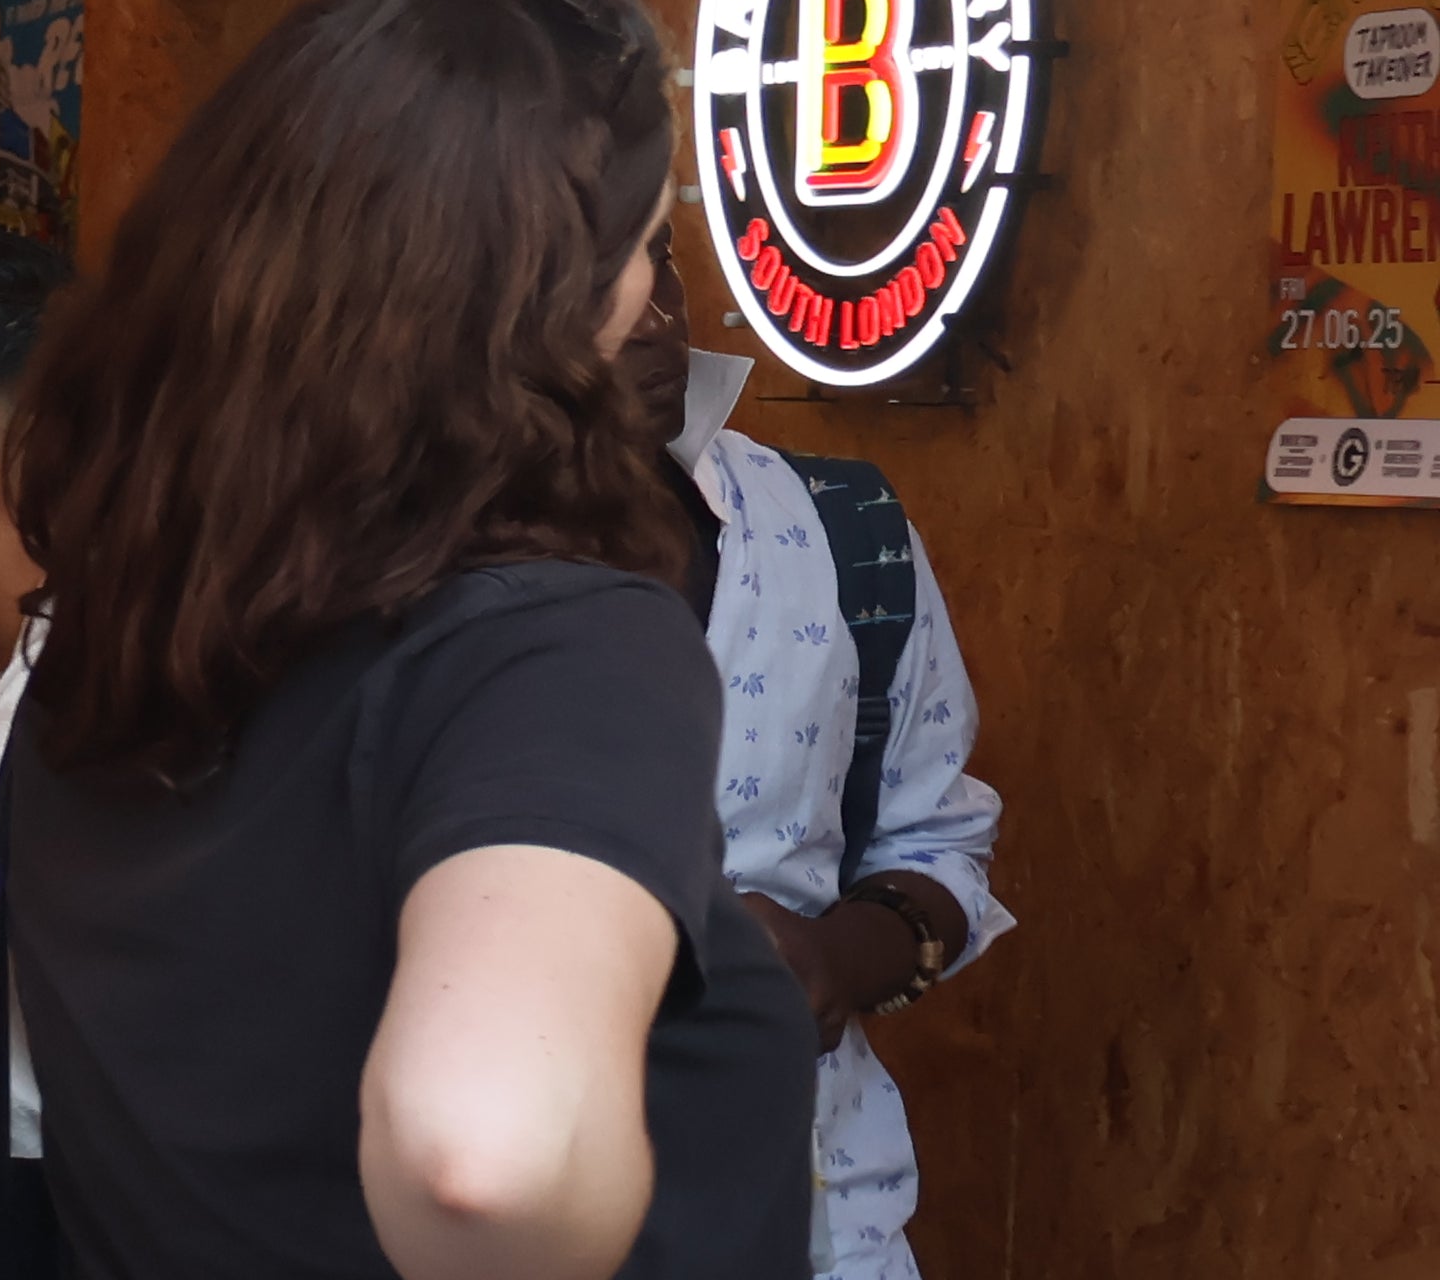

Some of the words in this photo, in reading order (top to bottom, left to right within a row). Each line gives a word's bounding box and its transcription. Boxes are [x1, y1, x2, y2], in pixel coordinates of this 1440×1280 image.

[1356, 22, 1429, 52] TAPROOM
[1353, 52, 1434, 88] TAKEOVER
[736, 217, 835, 347] SOUTH
[840, 206, 967, 350] LONDON
[1279, 277, 1306, 301] FRI
[1280, 308, 1403, 350] 27.06.25
